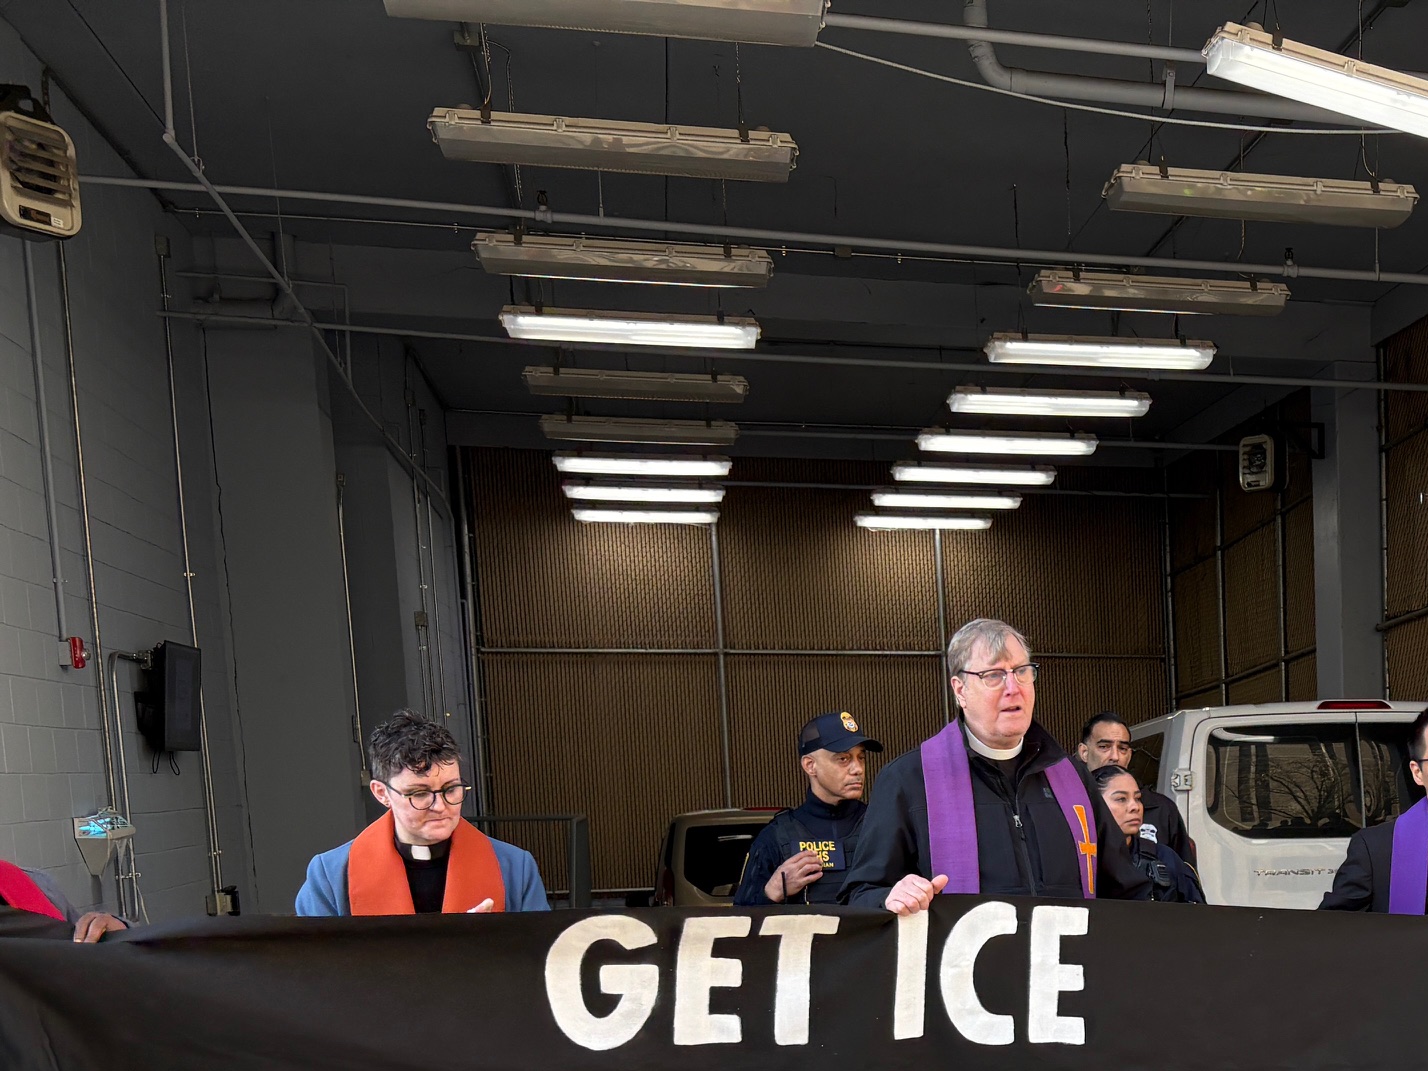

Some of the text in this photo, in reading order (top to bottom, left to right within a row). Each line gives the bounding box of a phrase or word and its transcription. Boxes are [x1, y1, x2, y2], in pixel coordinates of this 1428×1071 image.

[799, 841, 836, 851] POLICE
[1253, 868, 1326, 876] TRANSIT
[544, 901, 1089, 1051] GET ICE
